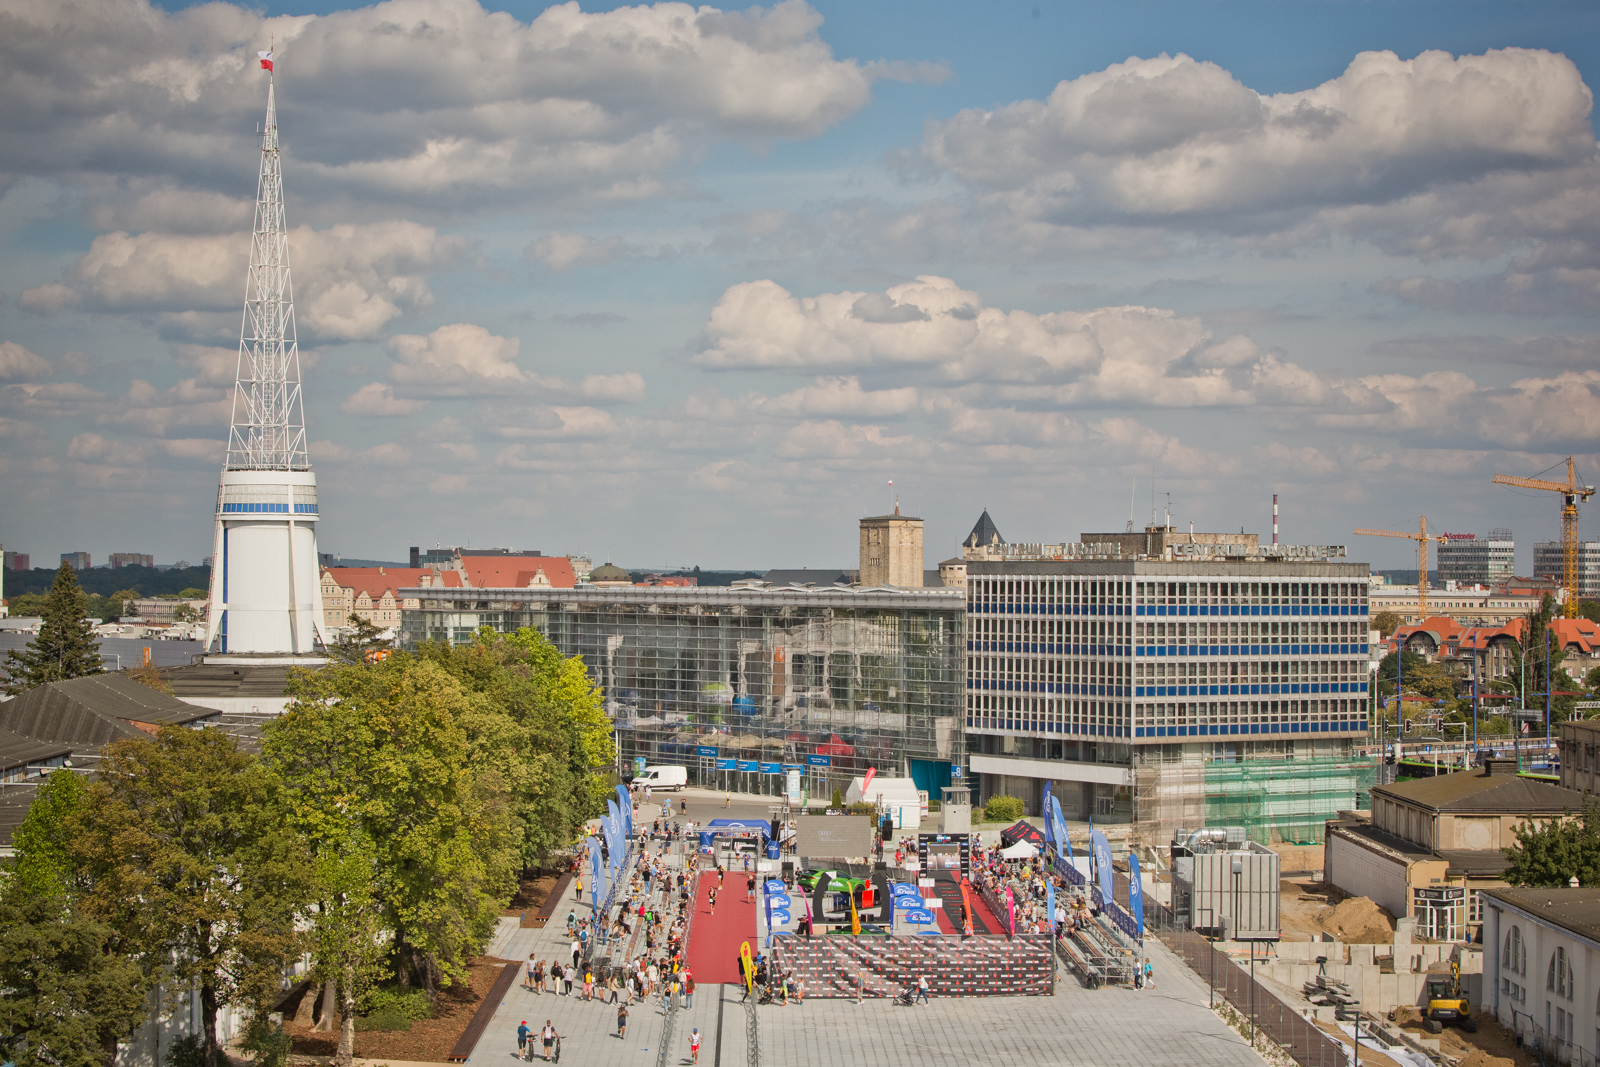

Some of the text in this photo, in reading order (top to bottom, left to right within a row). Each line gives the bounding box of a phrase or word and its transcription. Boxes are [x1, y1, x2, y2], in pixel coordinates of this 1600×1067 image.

[987, 543, 1044, 555] CENTRUM
[1173, 544, 1247, 556] CENTRUM
[956, 767, 961, 777] 8
